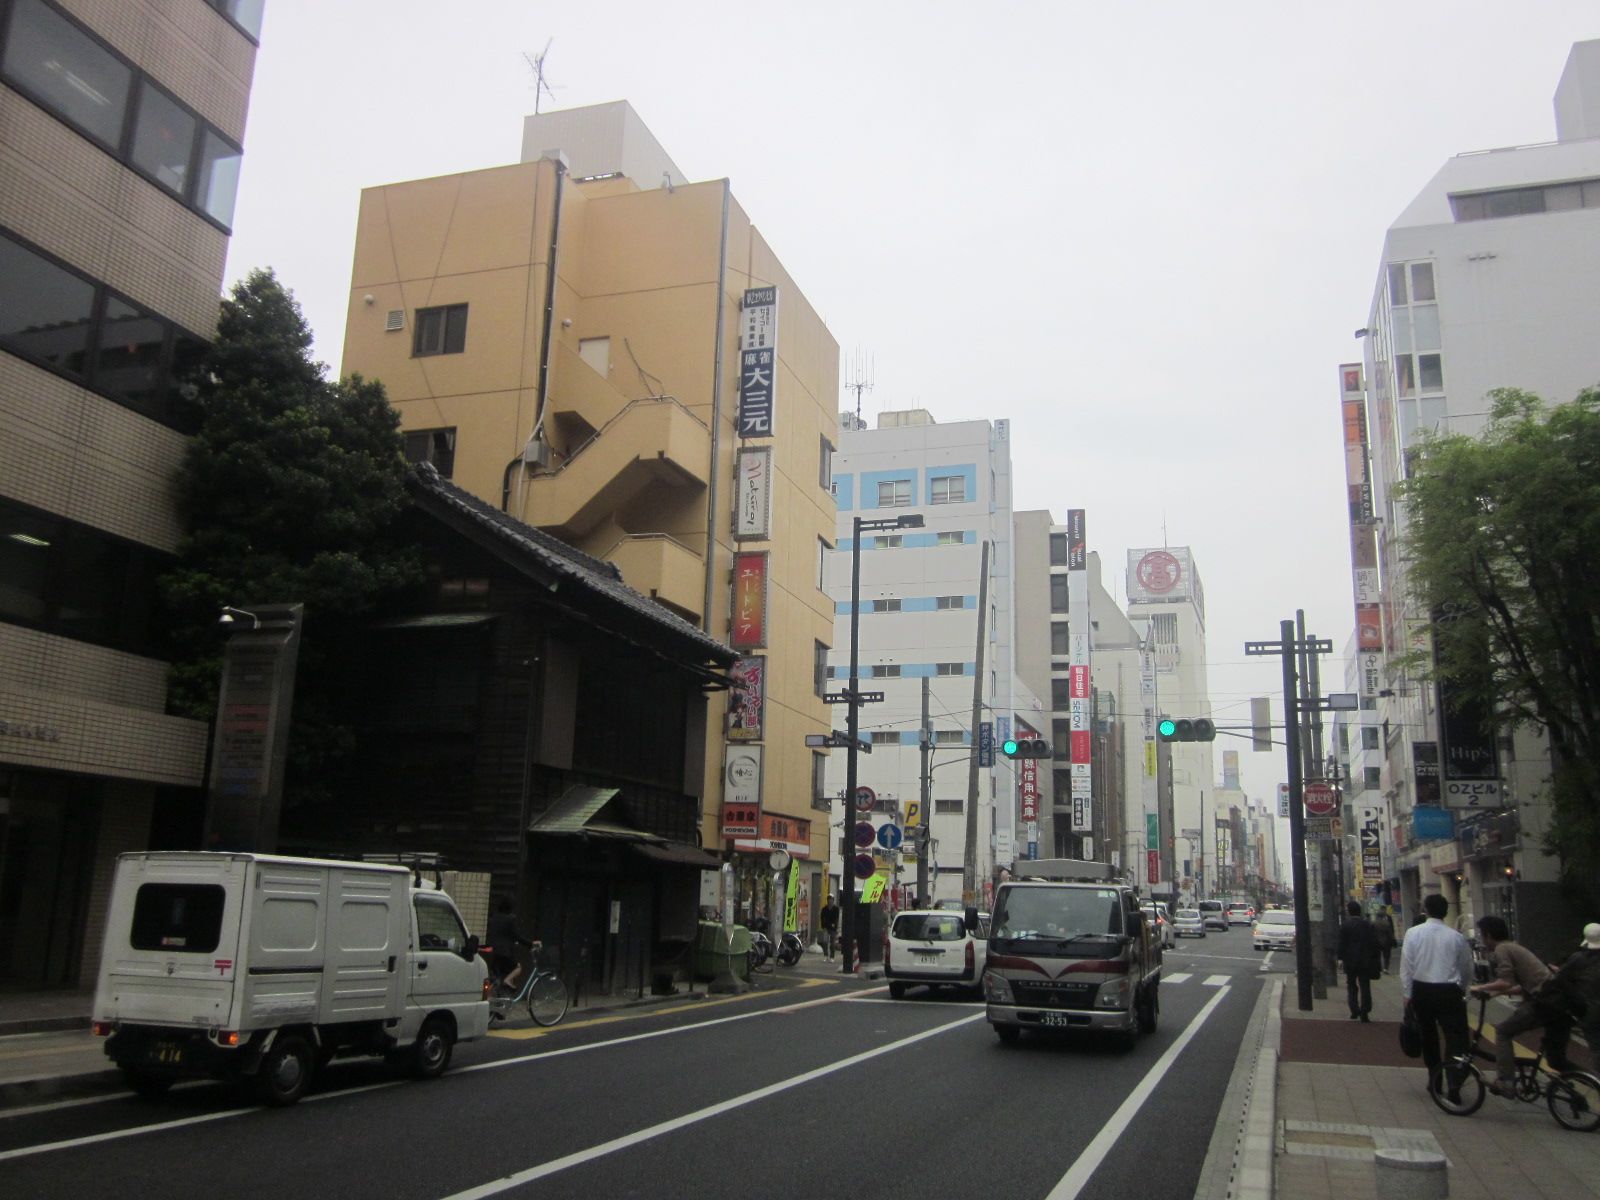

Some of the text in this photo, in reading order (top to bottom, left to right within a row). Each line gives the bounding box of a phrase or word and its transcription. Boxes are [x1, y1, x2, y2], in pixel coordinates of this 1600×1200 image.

[744, 351, 771, 365] 麻雀
[743, 367, 770, 432] 大三元
[1073, 700, 1081, 729] SECOM
[1449, 783, 1498, 795] OZビル
[1468, 795, 1479, 806] 2
[905, 803, 919, 824] P
